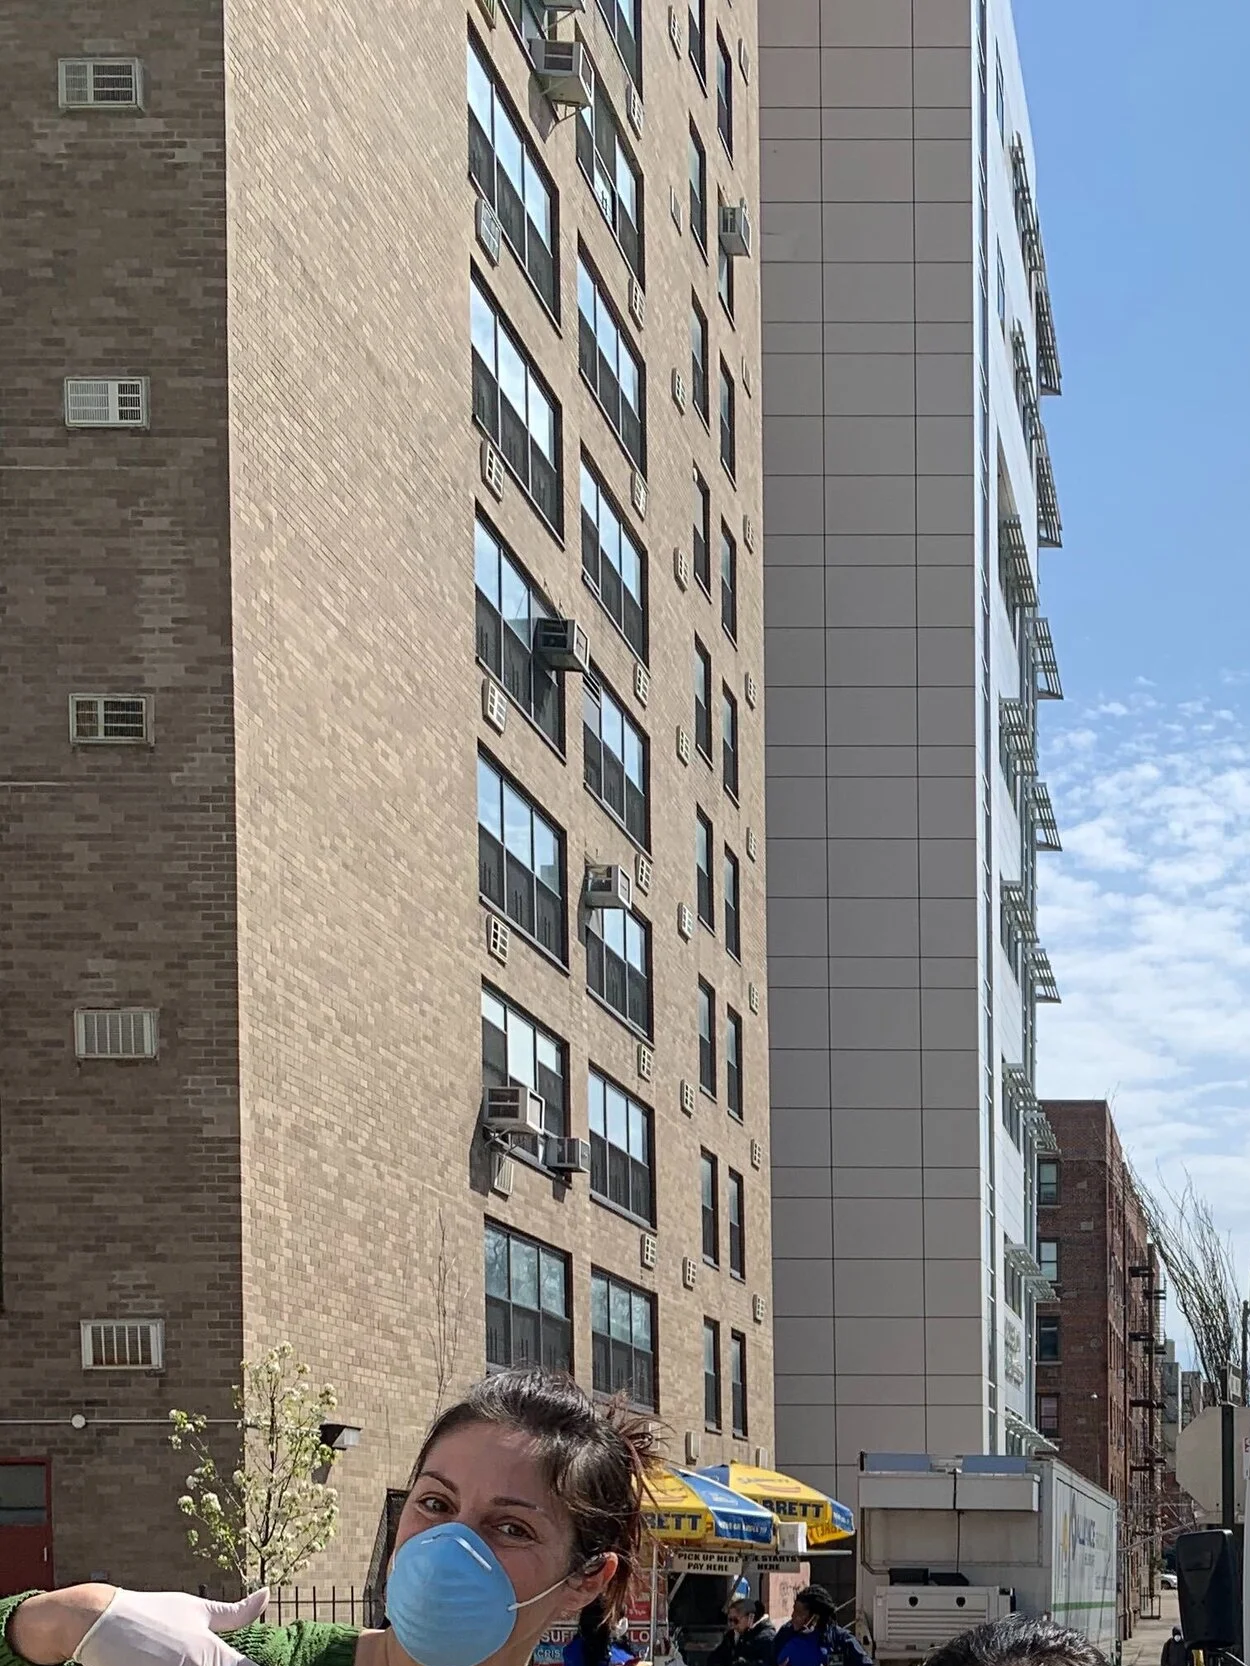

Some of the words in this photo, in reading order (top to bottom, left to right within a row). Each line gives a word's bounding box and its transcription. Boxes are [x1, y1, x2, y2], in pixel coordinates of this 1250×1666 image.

[678, 1553, 700, 1561] PICK
[702, 1554, 715, 1562] UP
[717, 1555, 739, 1563] HERE
[706, 1563, 728, 1572] HERE
